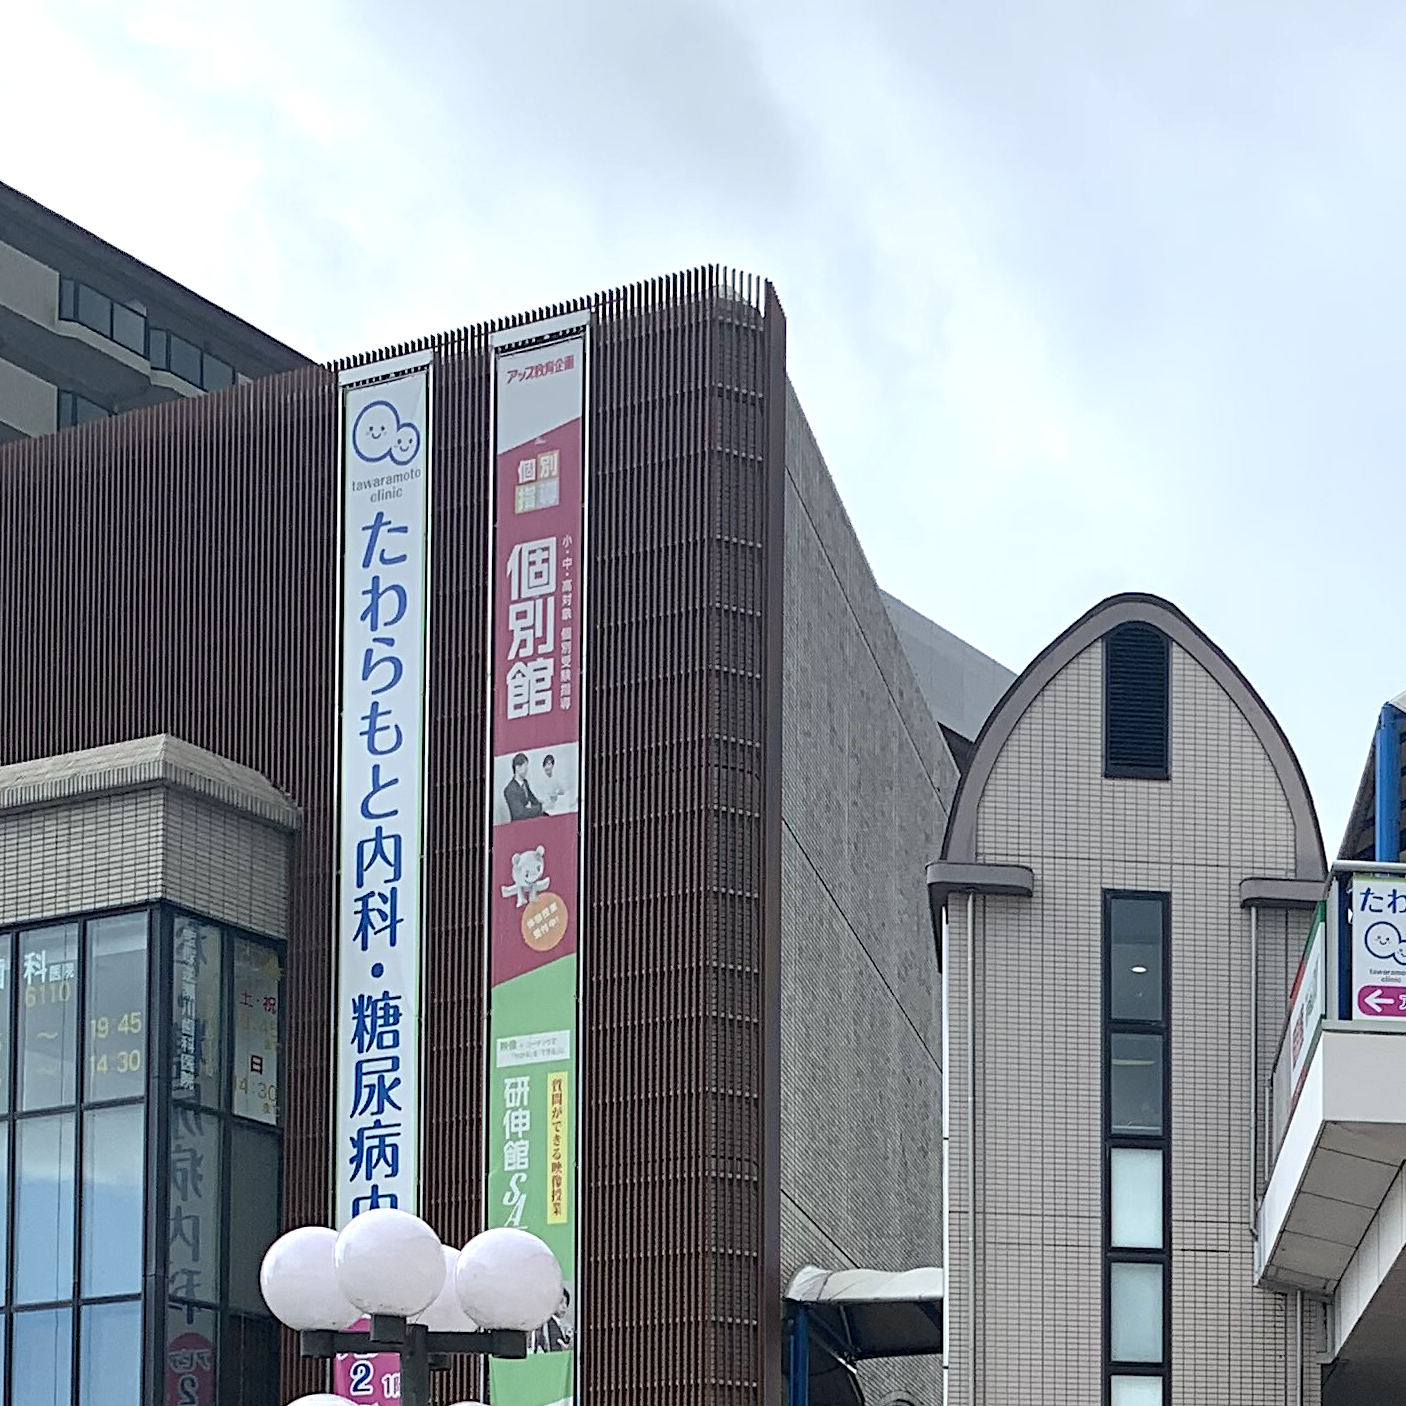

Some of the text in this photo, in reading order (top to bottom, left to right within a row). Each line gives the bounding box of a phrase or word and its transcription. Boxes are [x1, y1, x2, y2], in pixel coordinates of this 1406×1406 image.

[352, 467, 421, 492] tawaramoto
[370, 487, 403, 503] clinic
[507, 536, 556, 719] 個別館
[250, 1055, 263, 1075] 日
